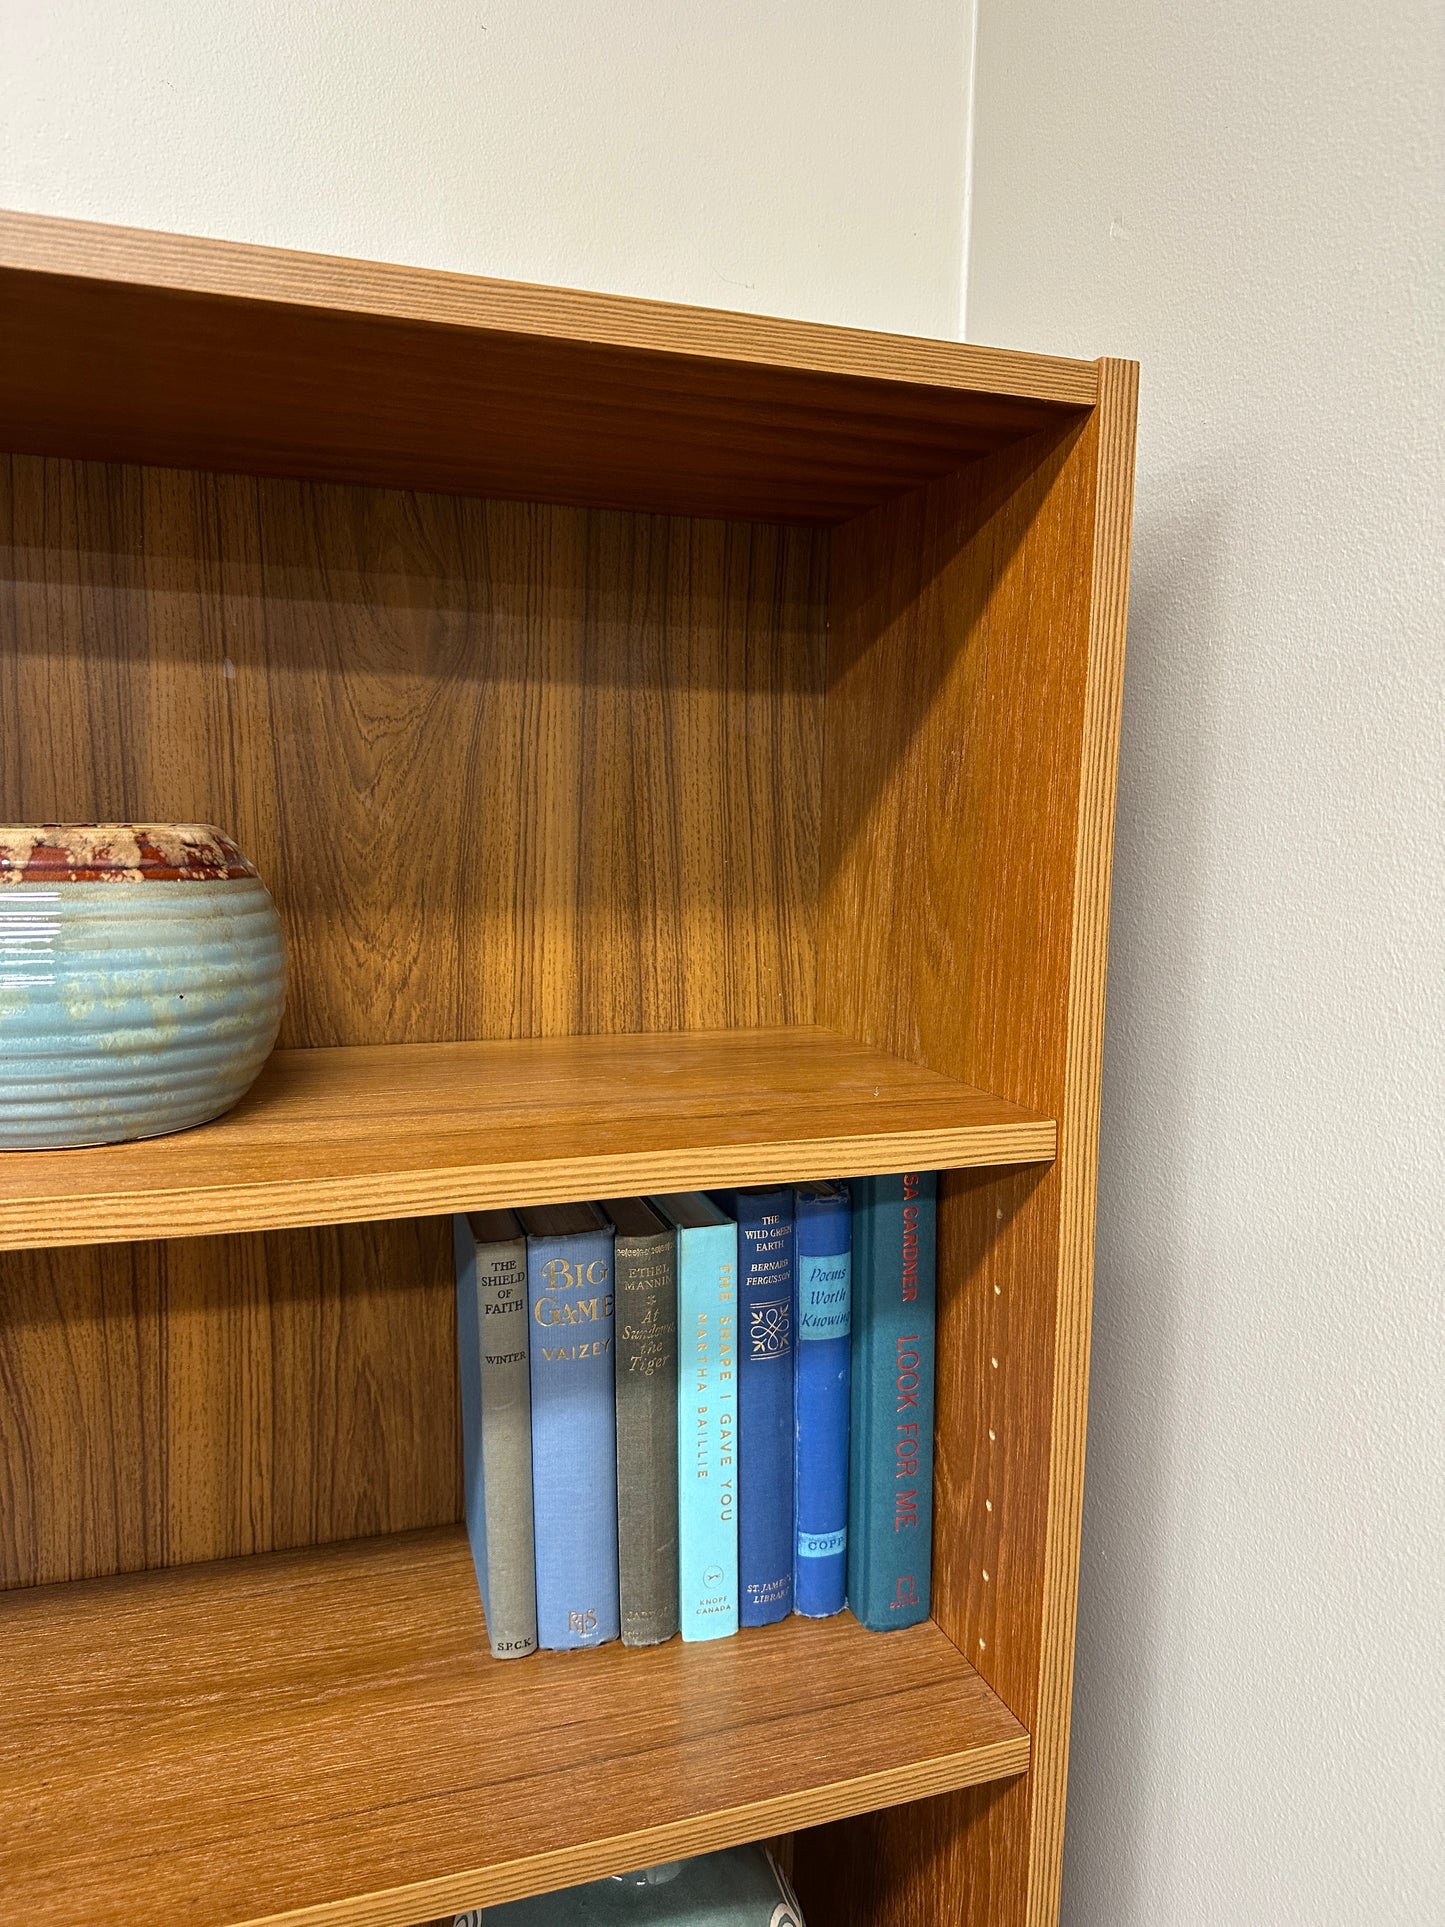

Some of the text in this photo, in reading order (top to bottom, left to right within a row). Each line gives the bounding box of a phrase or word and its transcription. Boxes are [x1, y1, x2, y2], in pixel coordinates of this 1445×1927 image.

[762, 1214, 780, 1226] THE
[744, 1224, 793, 1240] WILD GREEN
[756, 1240, 784, 1252] EARTH
[902, 1206, 919, 1302] GARDNER
[491, 1260, 517, 1272] THE
[541, 1257, 609, 1291] BIG
[628, 1263, 670, 1279] ETHEL
[481, 1271, 526, 1287] SHIELD
[624, 1273, 673, 1291] MANNIN
[719, 1263, 732, 1301] THE
[746, 1270, 792, 1286] FERGUSSON
[810, 1267, 846, 1282] Poems
[497, 1288, 513, 1299] OF
[810, 1287, 846, 1305] Worth
[485, 1299, 524, 1315] FAITH
[534, 1293, 614, 1328] GAME
[641, 1308, 659, 1324] At
[541, 1337, 612, 1361] VAIZEY
[640, 1340, 664, 1354] the
[719, 1315, 732, 1381] SHAPE
[485, 1351, 527, 1365] WINTER
[629, 1354, 670, 1376] Tiger
[697, 1312, 709, 1479] MARTHA BAILLIE
[720, 1413, 733, 1467] GAVE
[894, 1335, 920, 1533] LOOK FOR ME
[720, 1479, 733, 1521] YOU
[746, 1584, 760, 1592] ST.
[699, 1596, 729, 1606] KNOPF
[696, 1604, 732, 1615] CANADA
